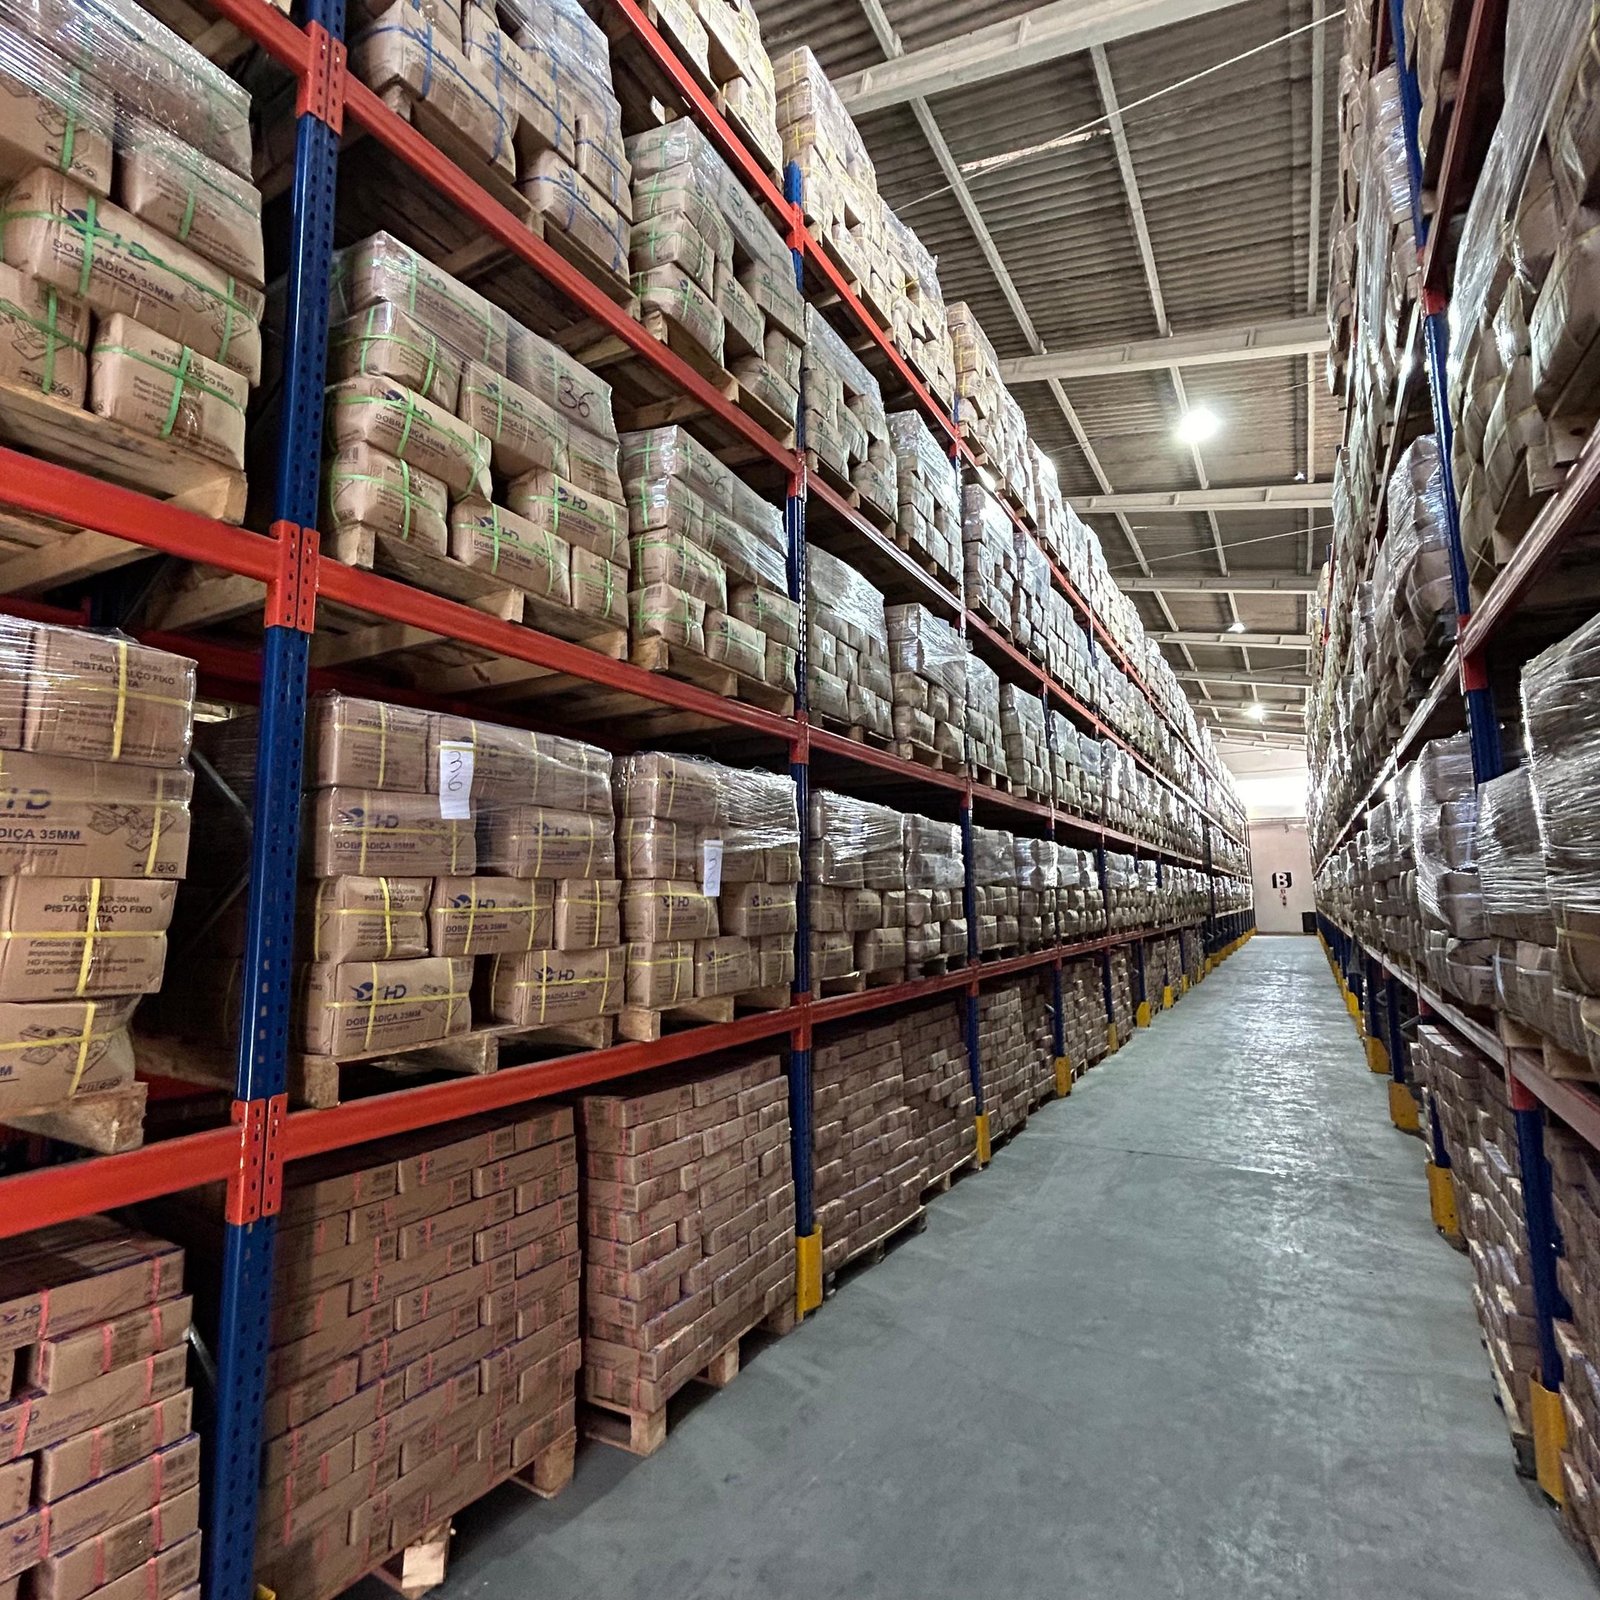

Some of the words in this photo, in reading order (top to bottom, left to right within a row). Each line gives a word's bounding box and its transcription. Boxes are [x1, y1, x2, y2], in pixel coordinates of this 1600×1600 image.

[53, 238, 138, 284] DOBADIÇA
[139, 281, 175, 302] 35MM
[558, 375, 595, 419] 36
[572, 495, 588, 511] HD
[72, 659, 113, 674] PISTÃO
[153, 674, 176, 686] FIXO
[112, 677, 139, 688] RTA
[447, 750, 464, 792] 36
[374, 813, 400, 829] HD
[39, 829, 82, 841] 35MM
[1276, 871, 1288, 889] B
[43, 903, 88, 914] PISTÃO
[96, 904, 128, 915] ALÇO
[128, 905, 154, 914] FIXO
[558, 969, 576, 981] HD
[383, 983, 407, 1001] HD
